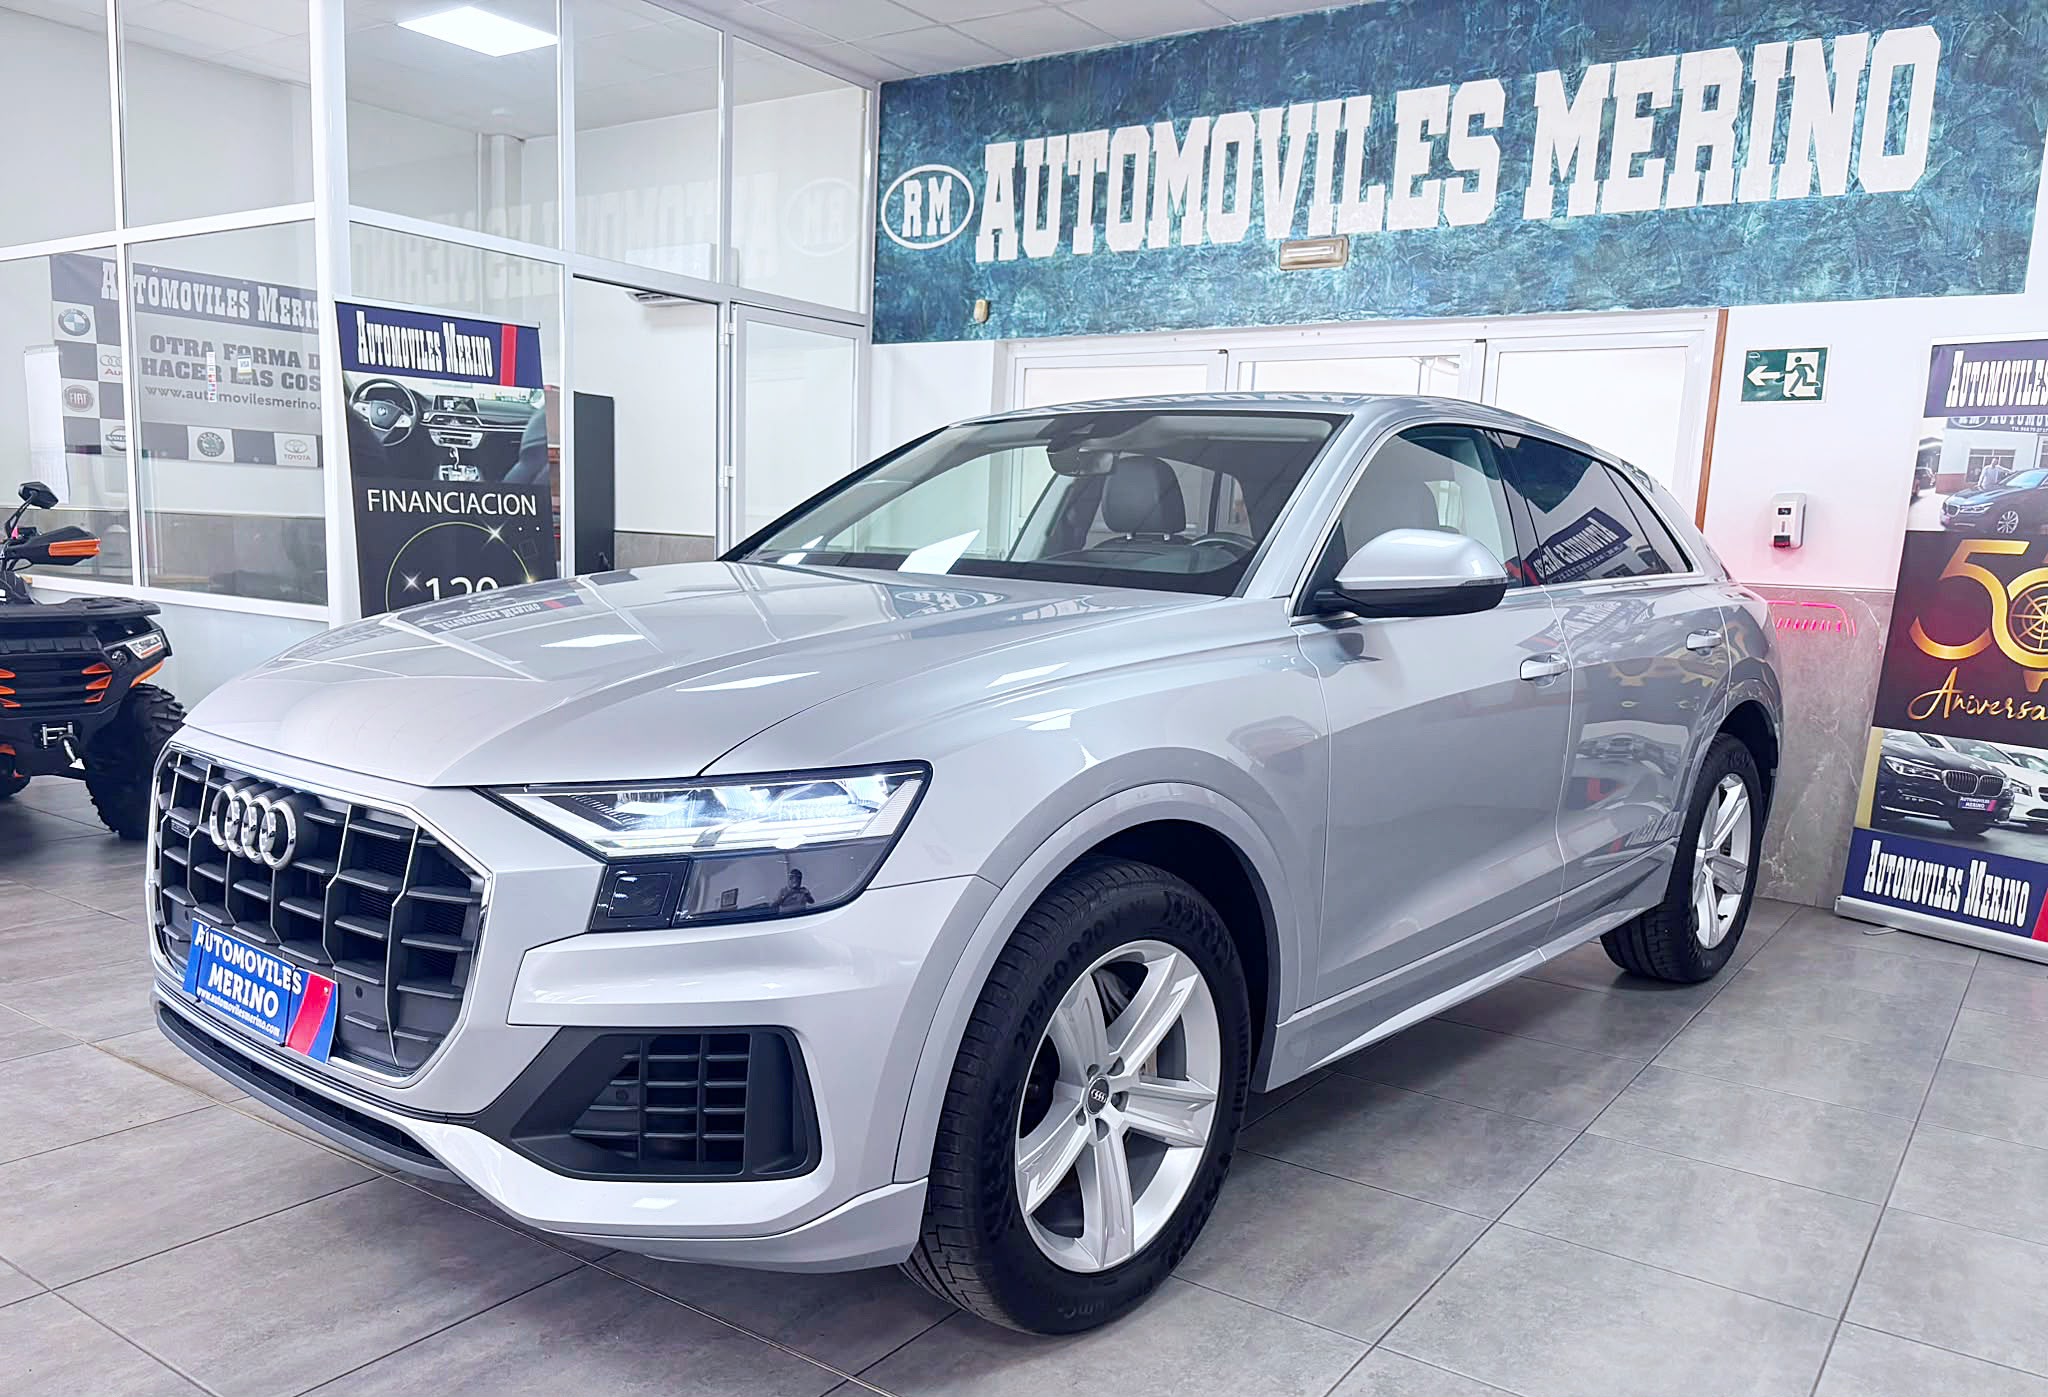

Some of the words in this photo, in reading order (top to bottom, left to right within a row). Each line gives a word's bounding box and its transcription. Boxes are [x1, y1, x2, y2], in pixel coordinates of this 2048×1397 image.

[975, 78, 1506, 263] AUTOMOVILES
[1523, 25, 1941, 220] MERINO
[902, 175, 952, 237] RM
[101, 261, 249, 320] ATOMOVILES
[150, 334, 214, 358] OTRA
[223, 343, 302, 369] FORMA
[308, 353, 320, 370] D
[356, 310, 443, 372] AUTOMOVILES
[443, 322, 494, 377] MERINO
[69, 392, 88, 405] FIAT
[104, 368, 123, 376] Au
[140, 357, 222, 383] HACER
[281, 372, 321, 392] COS
[145, 385, 321, 410] www.autmovilesmerino.
[1945, 350, 2048, 407] AUTOMOVILES
[367, 489, 537, 516] FINANCIACION
[1863, 840, 1963, 912] AUTOMOVILES
[1964, 859, 2030, 927] MERINO
[195, 924, 302, 994] AUTOMOVILES
[197, 987, 280, 1036] www.automovilesmerino.com
[208, 962, 279, 1018] MERINO
